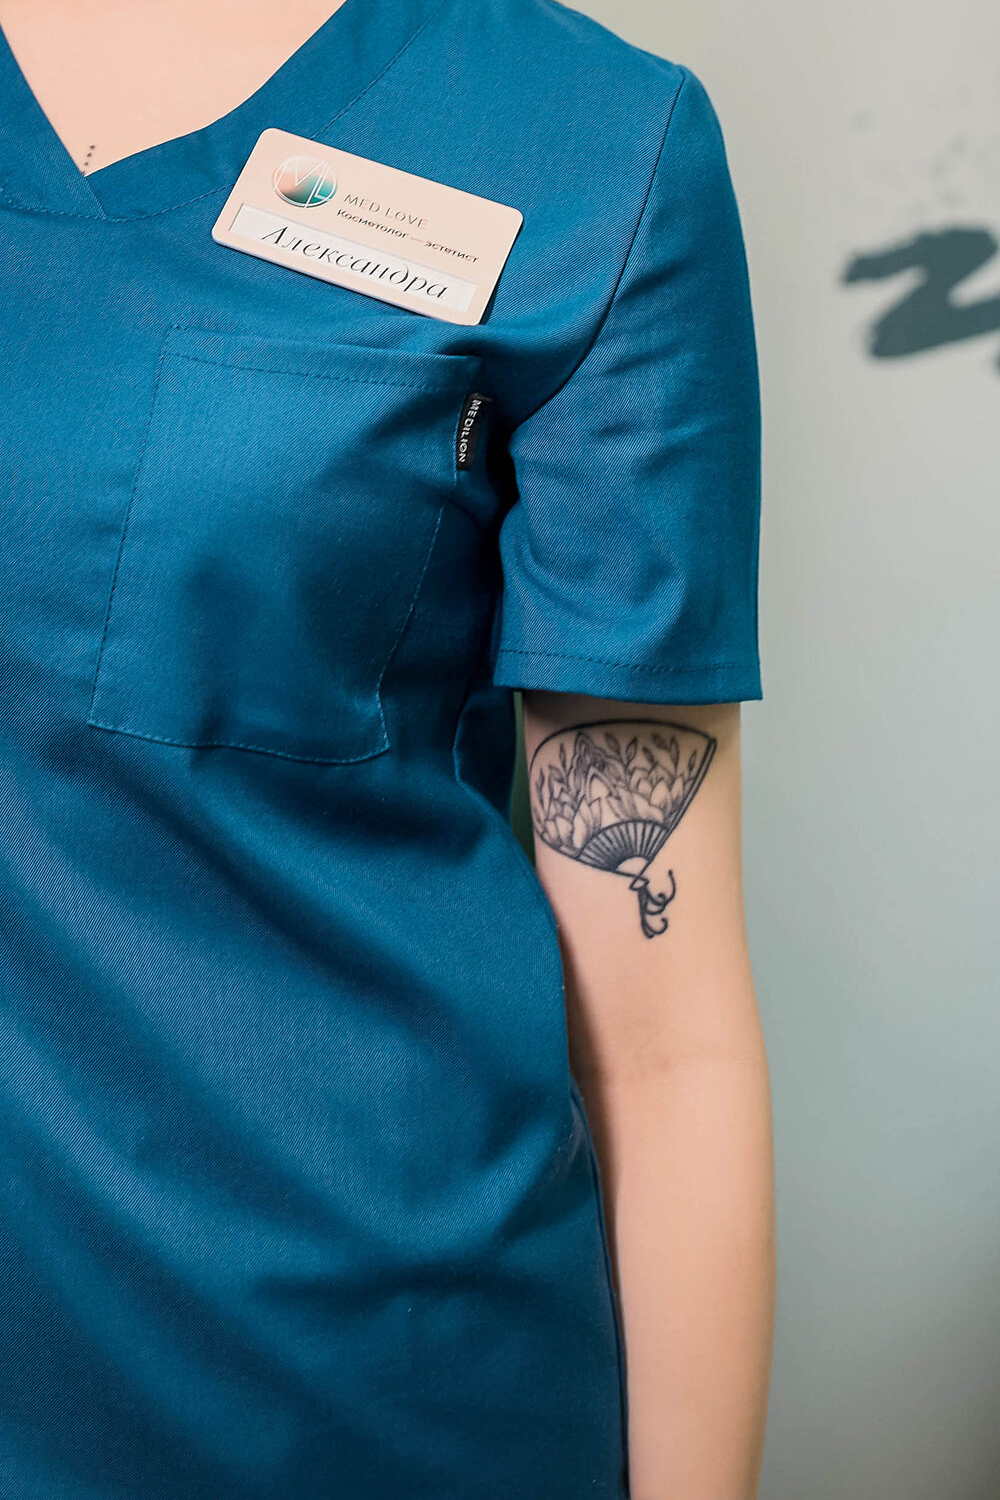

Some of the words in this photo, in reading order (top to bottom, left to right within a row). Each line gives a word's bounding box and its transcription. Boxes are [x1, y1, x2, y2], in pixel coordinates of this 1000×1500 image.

[336, 208, 408, 240] Косметолог
[424, 240, 480, 264] эстетист
[343, 193, 387, 214] MED
[385, 205, 429, 229] LOVE
[261, 225, 450, 299] Александра
[458, 399, 482, 463] MEDILION
